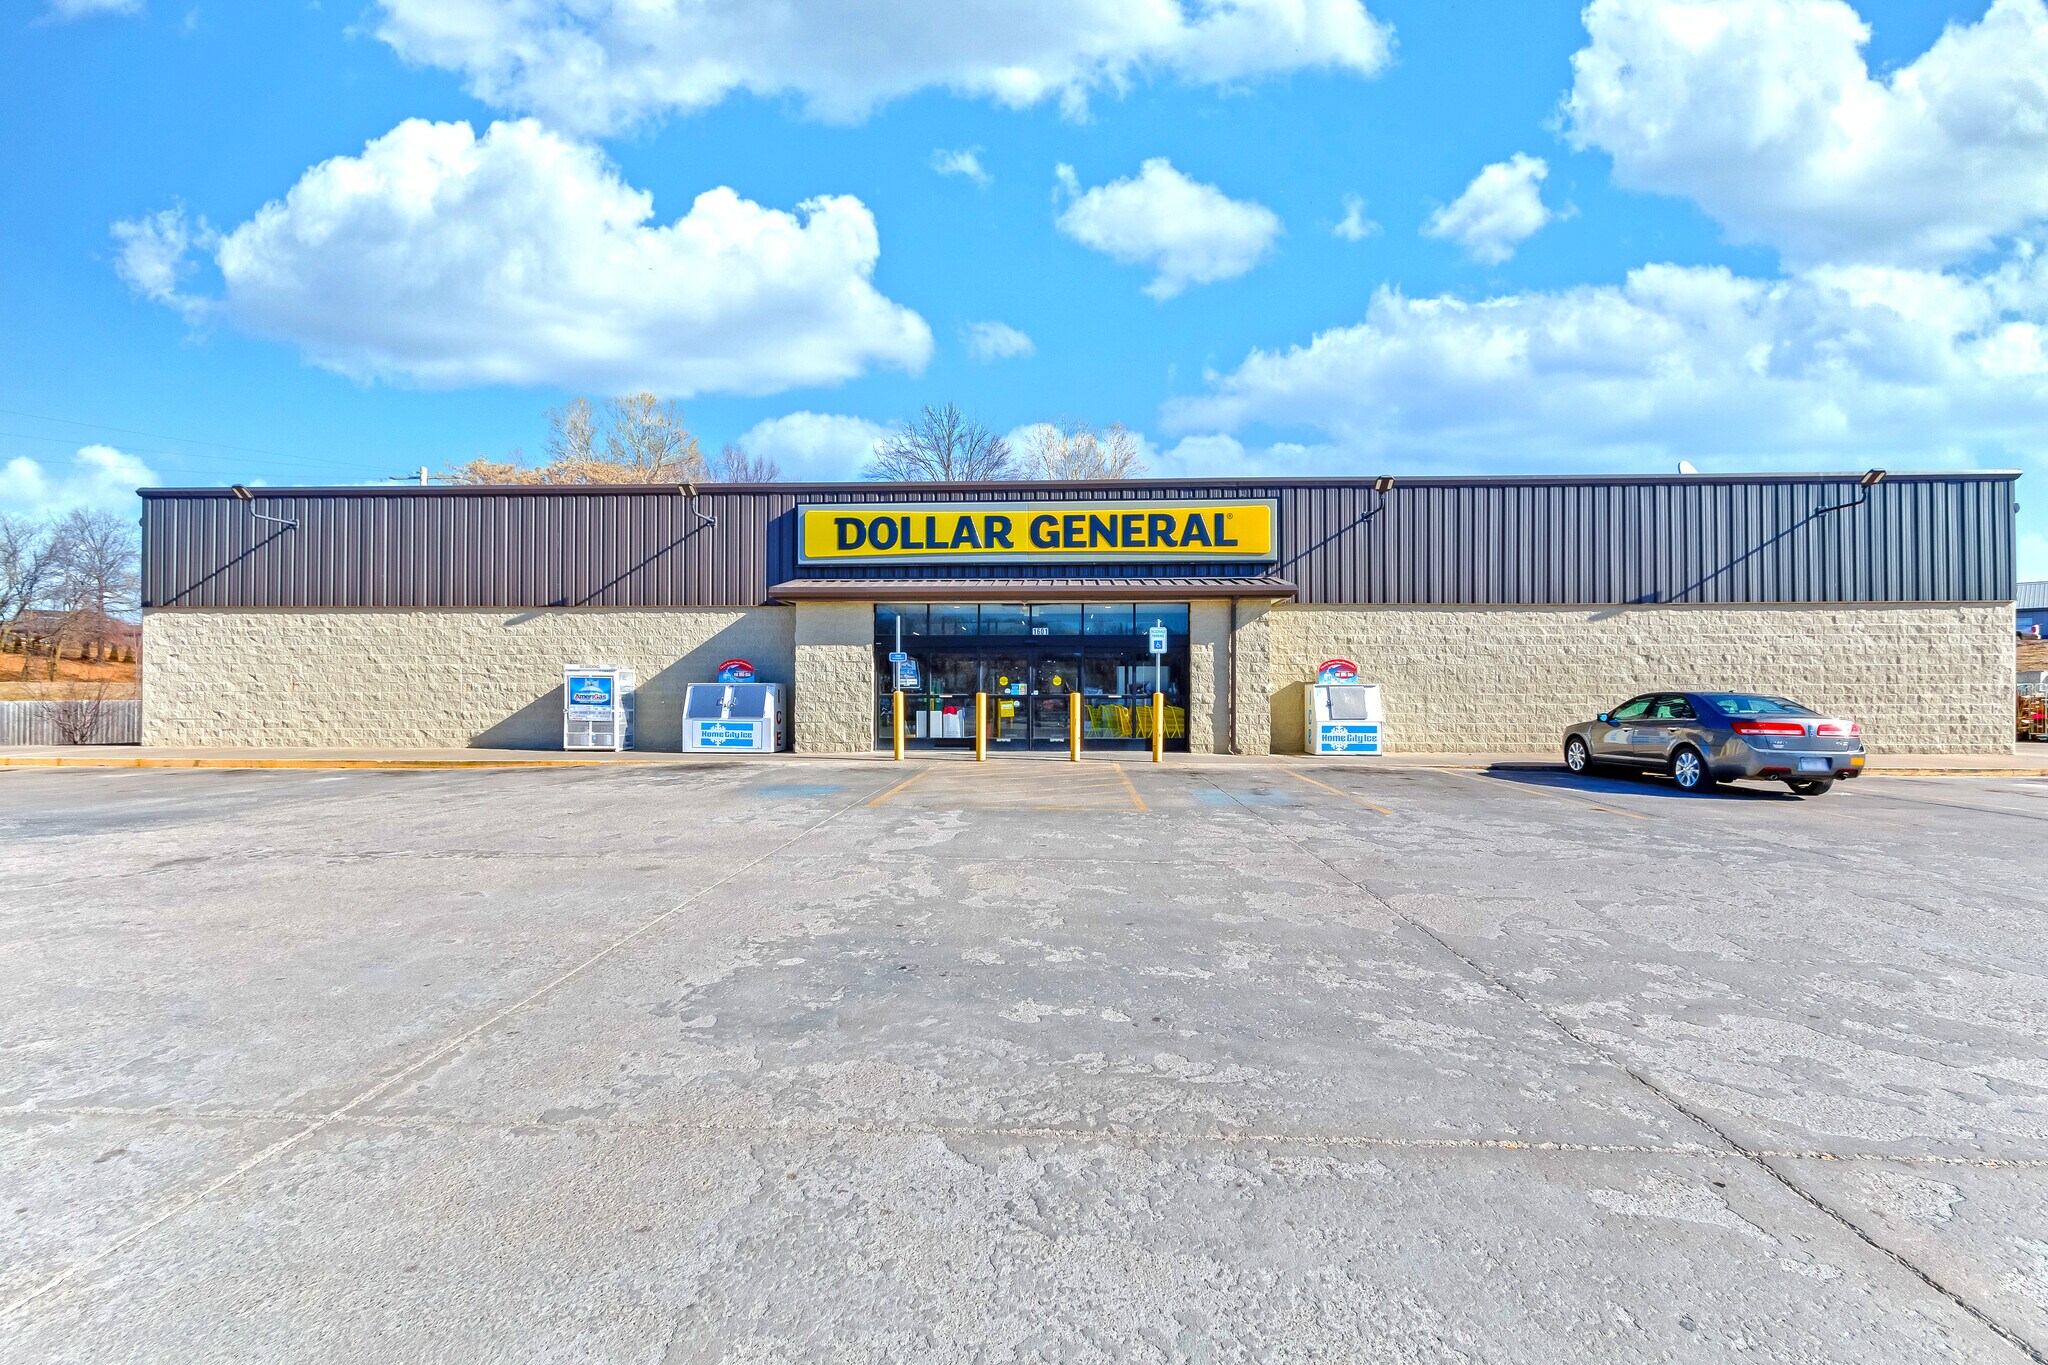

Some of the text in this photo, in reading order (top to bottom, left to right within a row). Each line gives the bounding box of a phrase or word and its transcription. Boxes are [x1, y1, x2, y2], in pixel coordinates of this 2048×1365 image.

[834, 513, 1238, 550] DOLLAR GENERAL
[724, 731, 740, 739] City
[1322, 734, 1377, 743] Home City Ice
